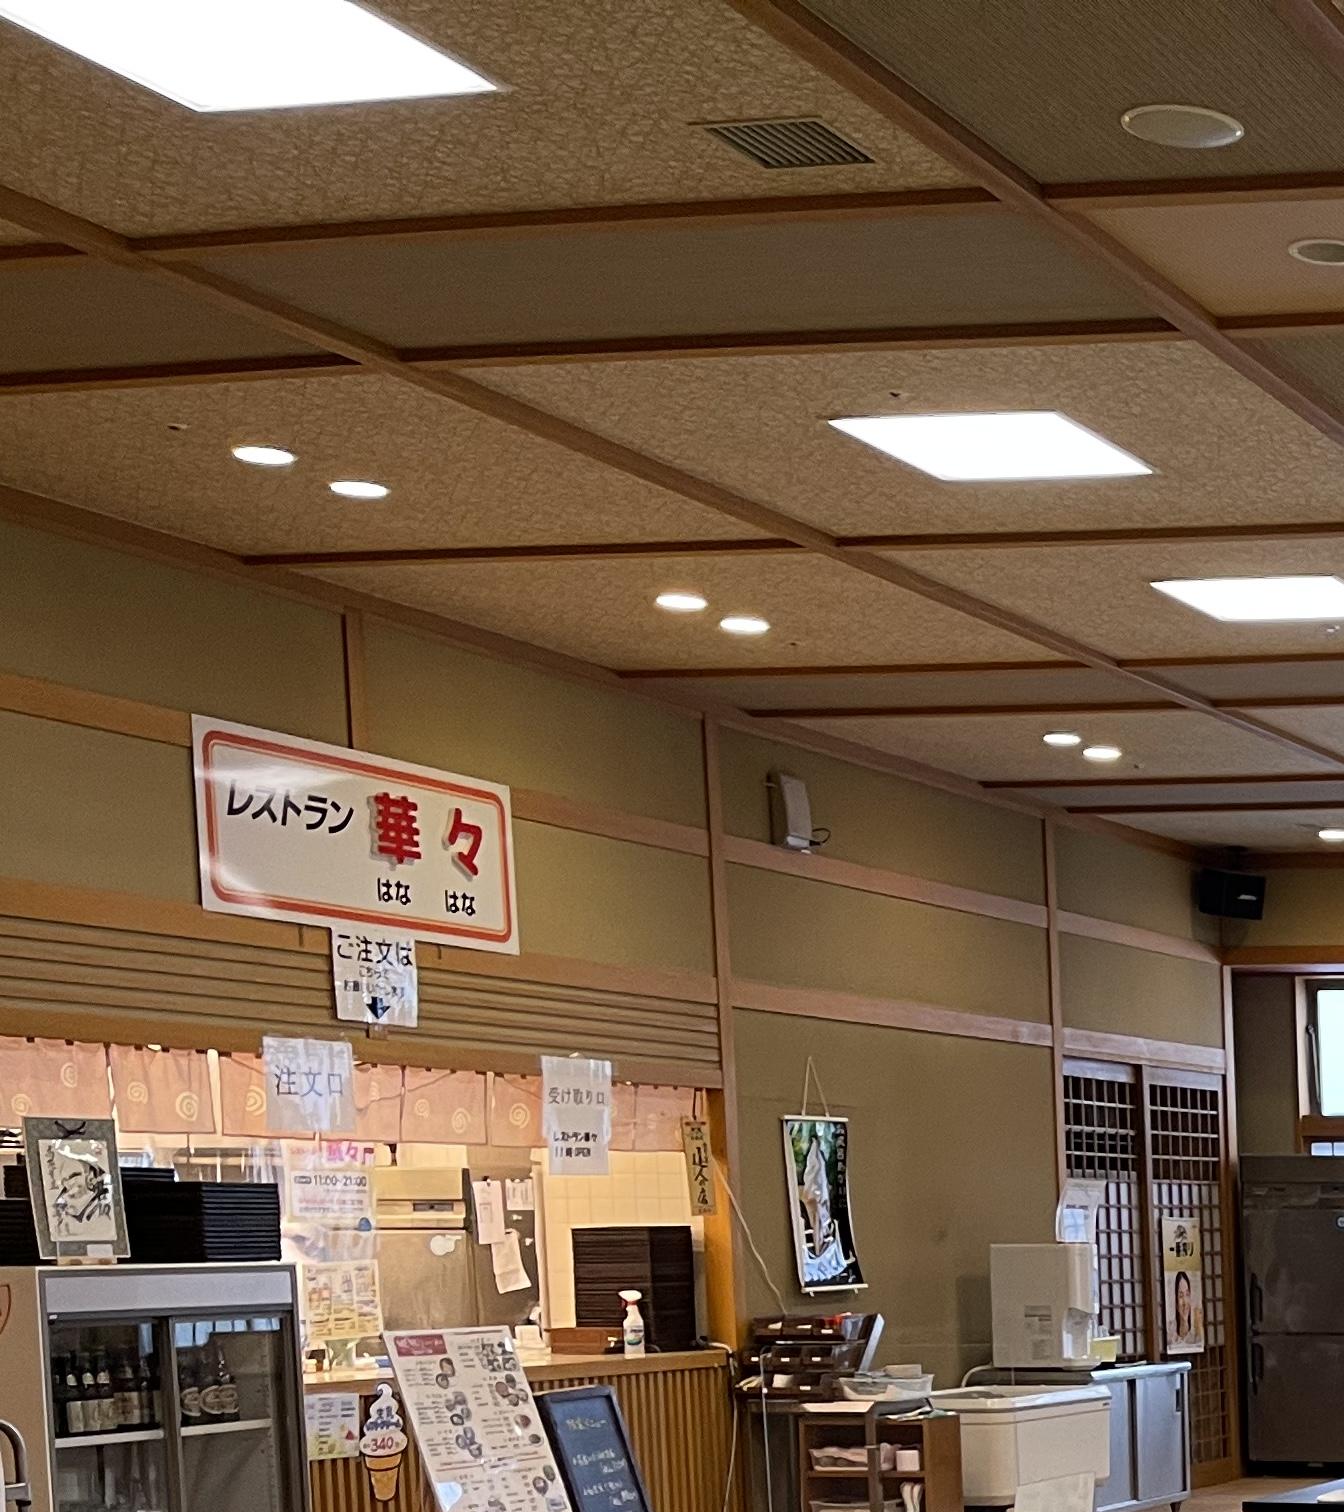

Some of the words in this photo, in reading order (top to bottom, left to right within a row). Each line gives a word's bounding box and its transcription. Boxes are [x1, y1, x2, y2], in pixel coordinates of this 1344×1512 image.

[227, 779, 354, 834] レストラン
[374, 791, 483, 877] 華々
[377, 878, 411, 906] はな
[444, 890, 476, 916] はな
[336, 934, 413, 967] ご注文は
[274, 1064, 344, 1097] 注文口
[548, 1087, 606, 1105] 受け取り口
[370, 1436, 394, 1452] 340
